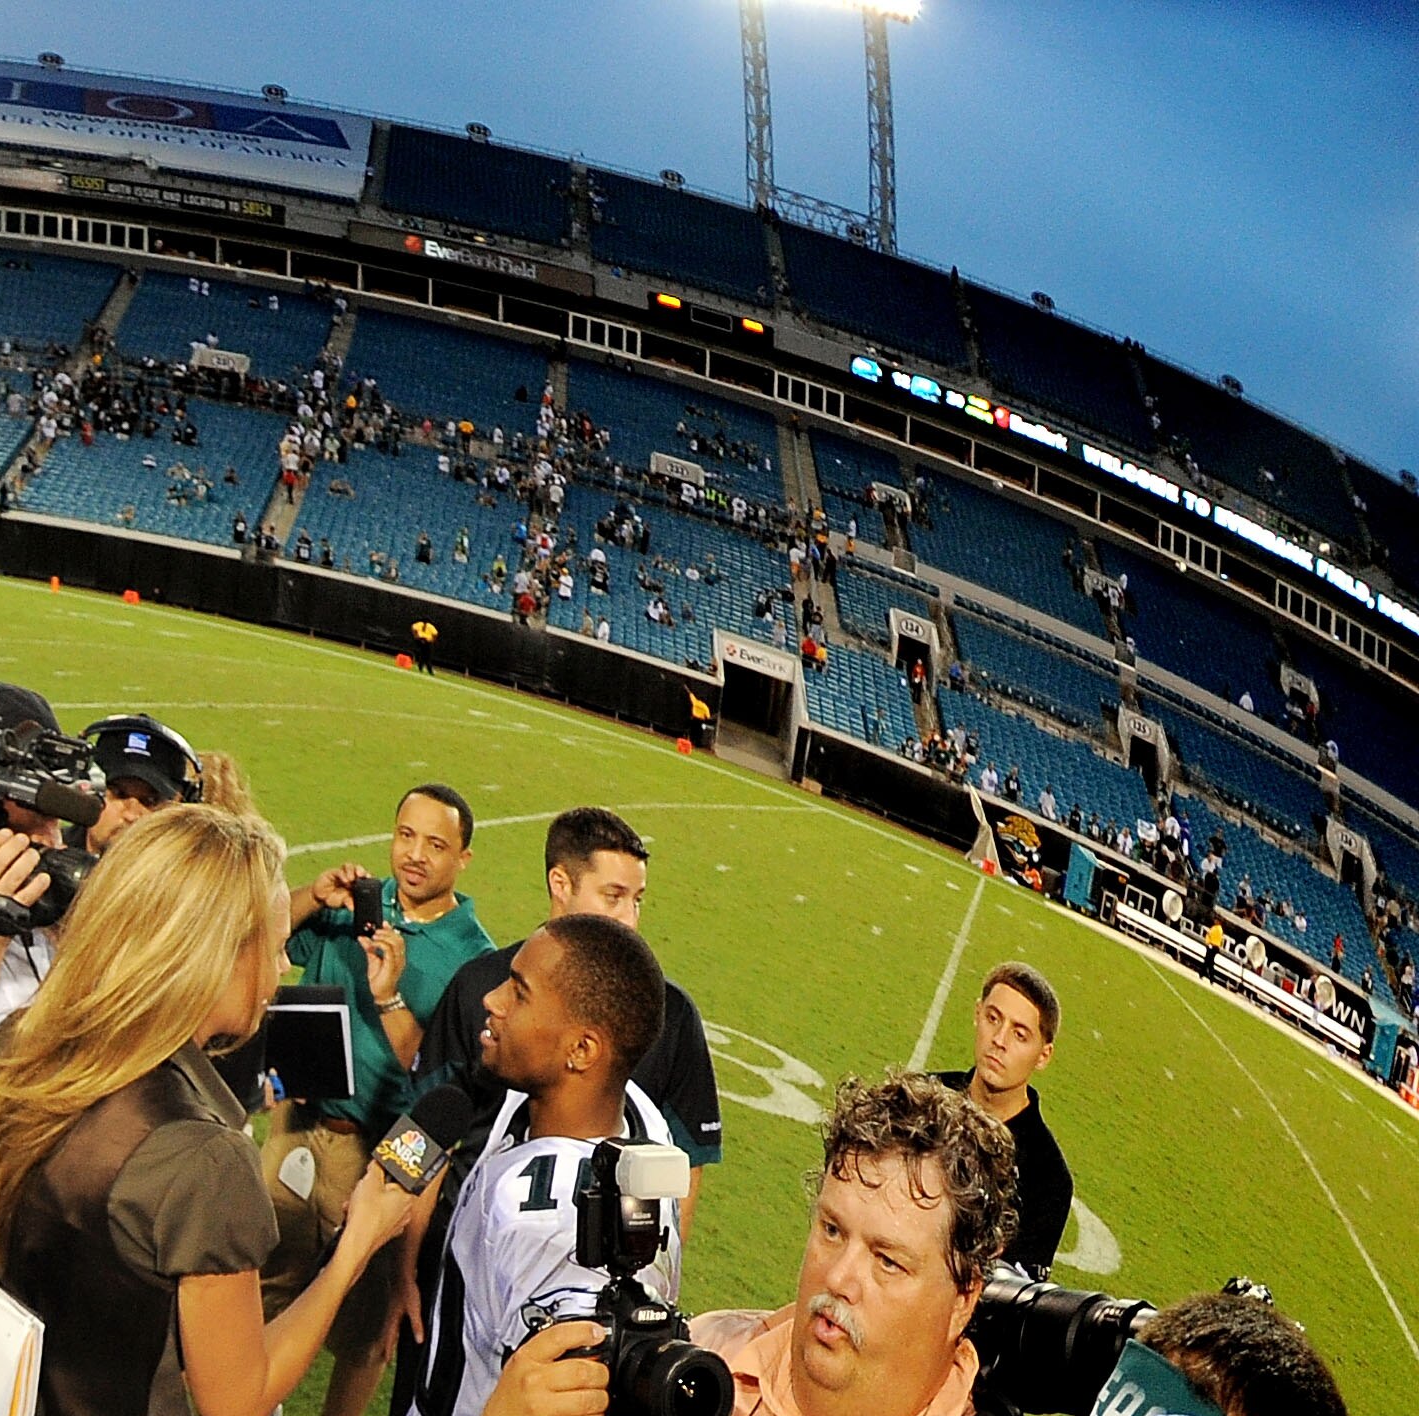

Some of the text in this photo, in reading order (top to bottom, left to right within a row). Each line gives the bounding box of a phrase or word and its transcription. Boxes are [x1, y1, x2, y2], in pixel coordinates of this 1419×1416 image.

[1082, 443, 1180, 504] WELCOME
[1182, 490, 1211, 518] TO
[390, 1136, 422, 1170] NBC
[637, 1309, 668, 1322] Nikon
